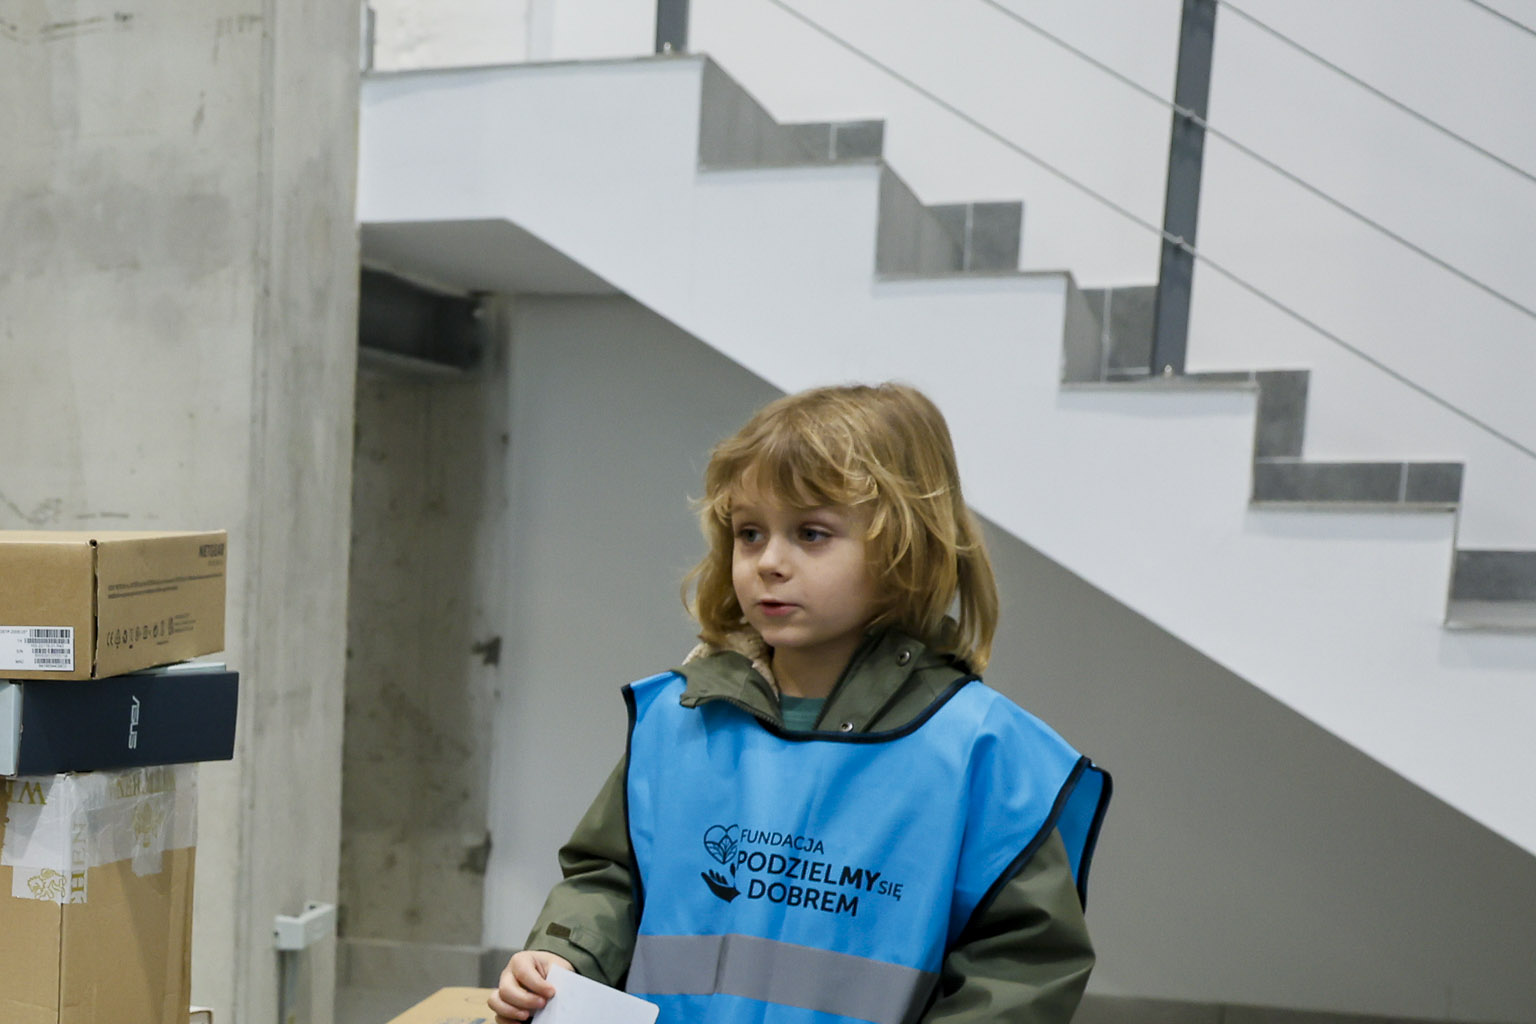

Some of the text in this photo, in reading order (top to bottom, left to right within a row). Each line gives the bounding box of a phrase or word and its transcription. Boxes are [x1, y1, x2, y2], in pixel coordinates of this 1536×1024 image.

[128, 695, 140, 749] ASUS
[741, 829, 824, 855] FUNDACJA
[747, 879, 859, 917] DOBREM
